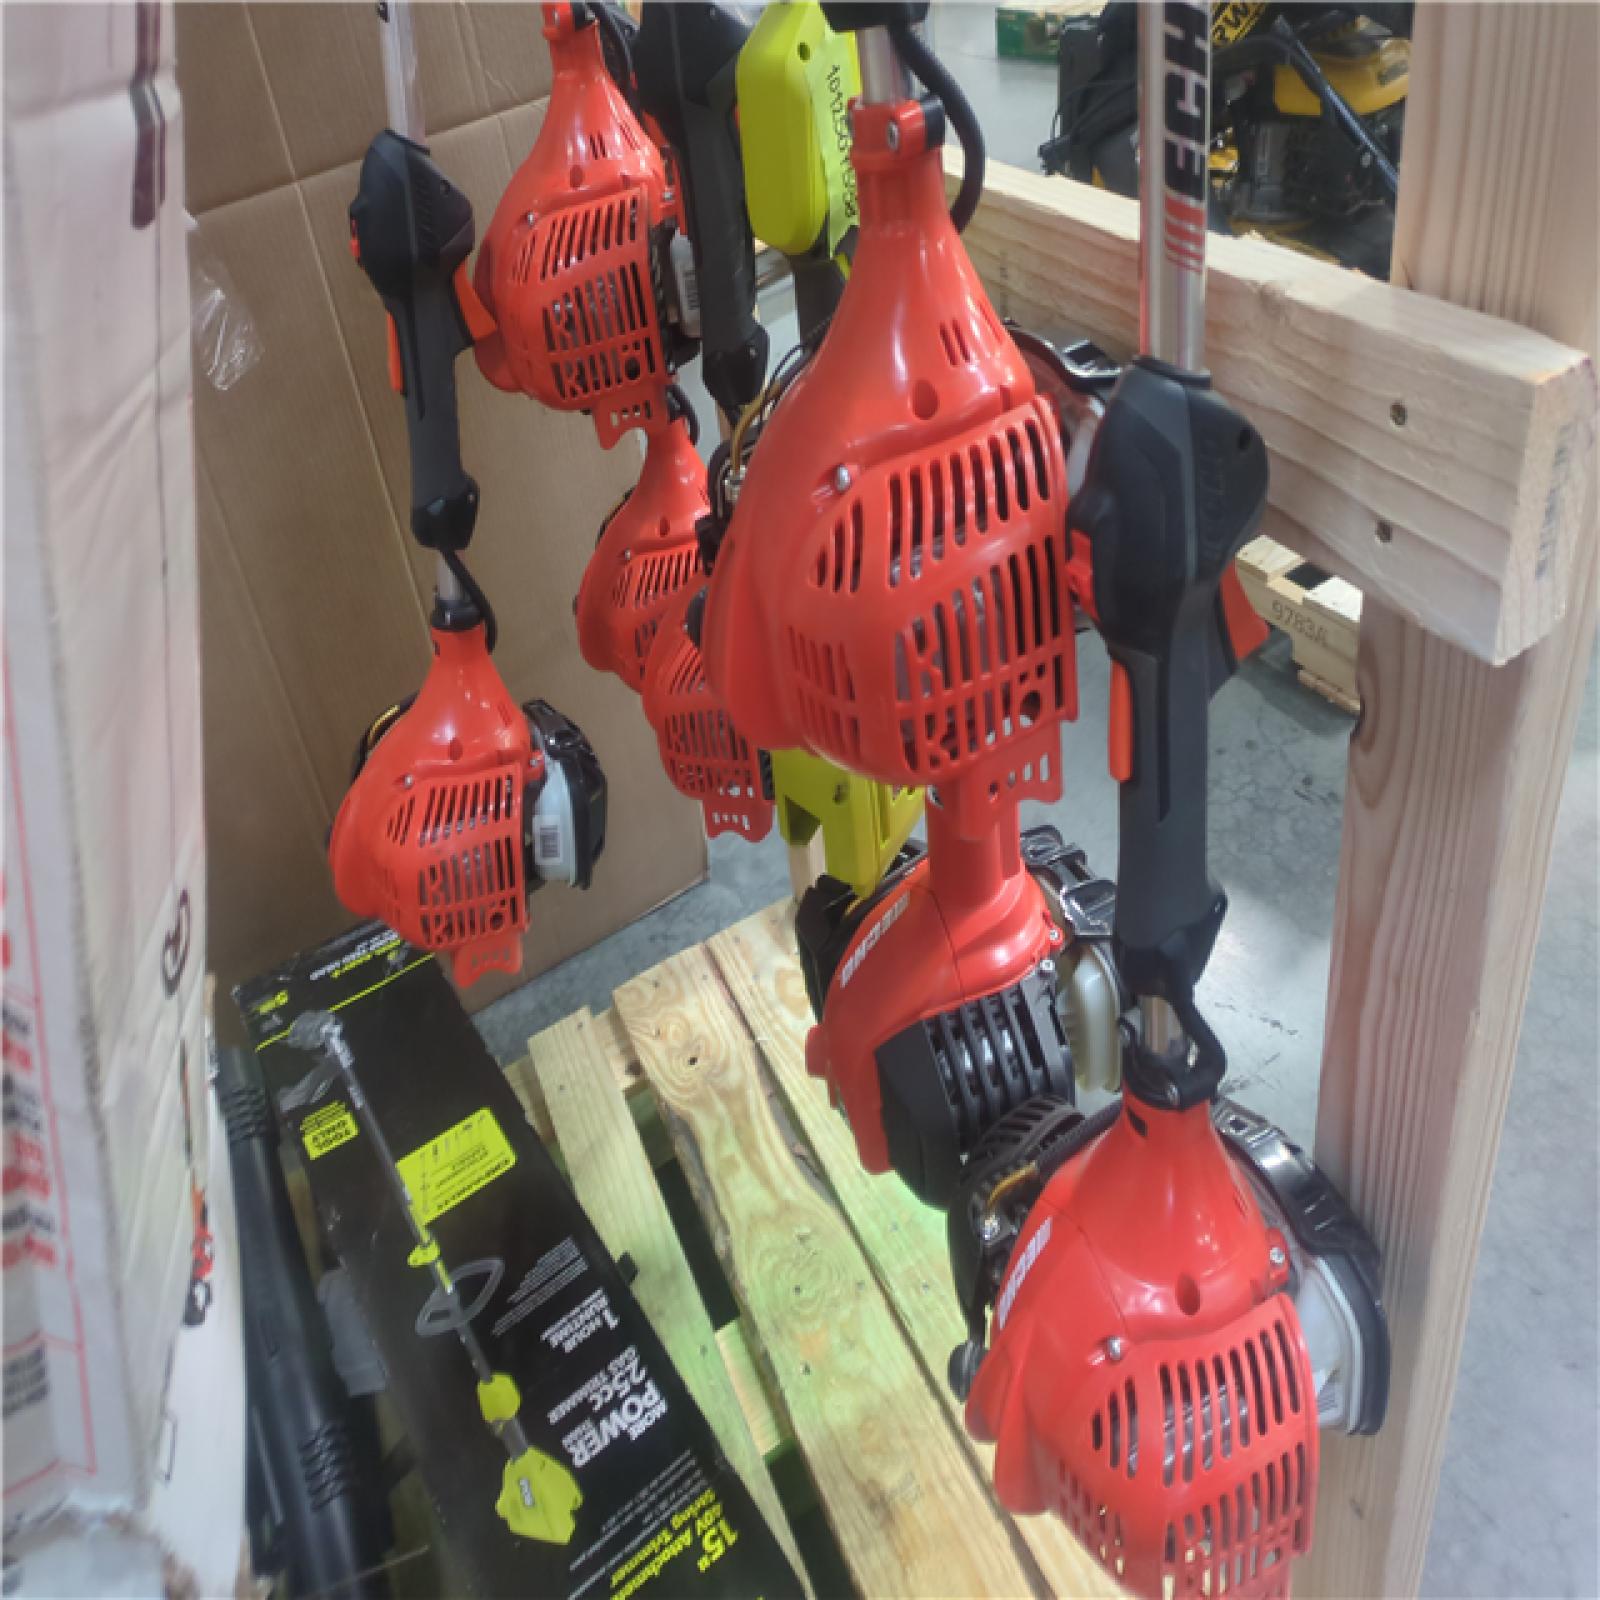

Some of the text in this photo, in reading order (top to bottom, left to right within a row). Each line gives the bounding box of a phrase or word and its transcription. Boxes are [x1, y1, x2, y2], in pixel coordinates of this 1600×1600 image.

[549, 1295, 607, 1348] RUNTIME
[562, 1315, 601, 1354] HOUR
[601, 1308, 618, 1329] 1
[547, 1345, 635, 1425] GAS TRIMMER
[568, 1378, 660, 1467] POWER
[628, 1398, 666, 1440] MORE
[670, 1487, 713, 1530] String
[695, 1502, 720, 1535] 40V
[610, 1526, 690, 1599] Attachmen
[611, 1528, 672, 1587] Trimmer
